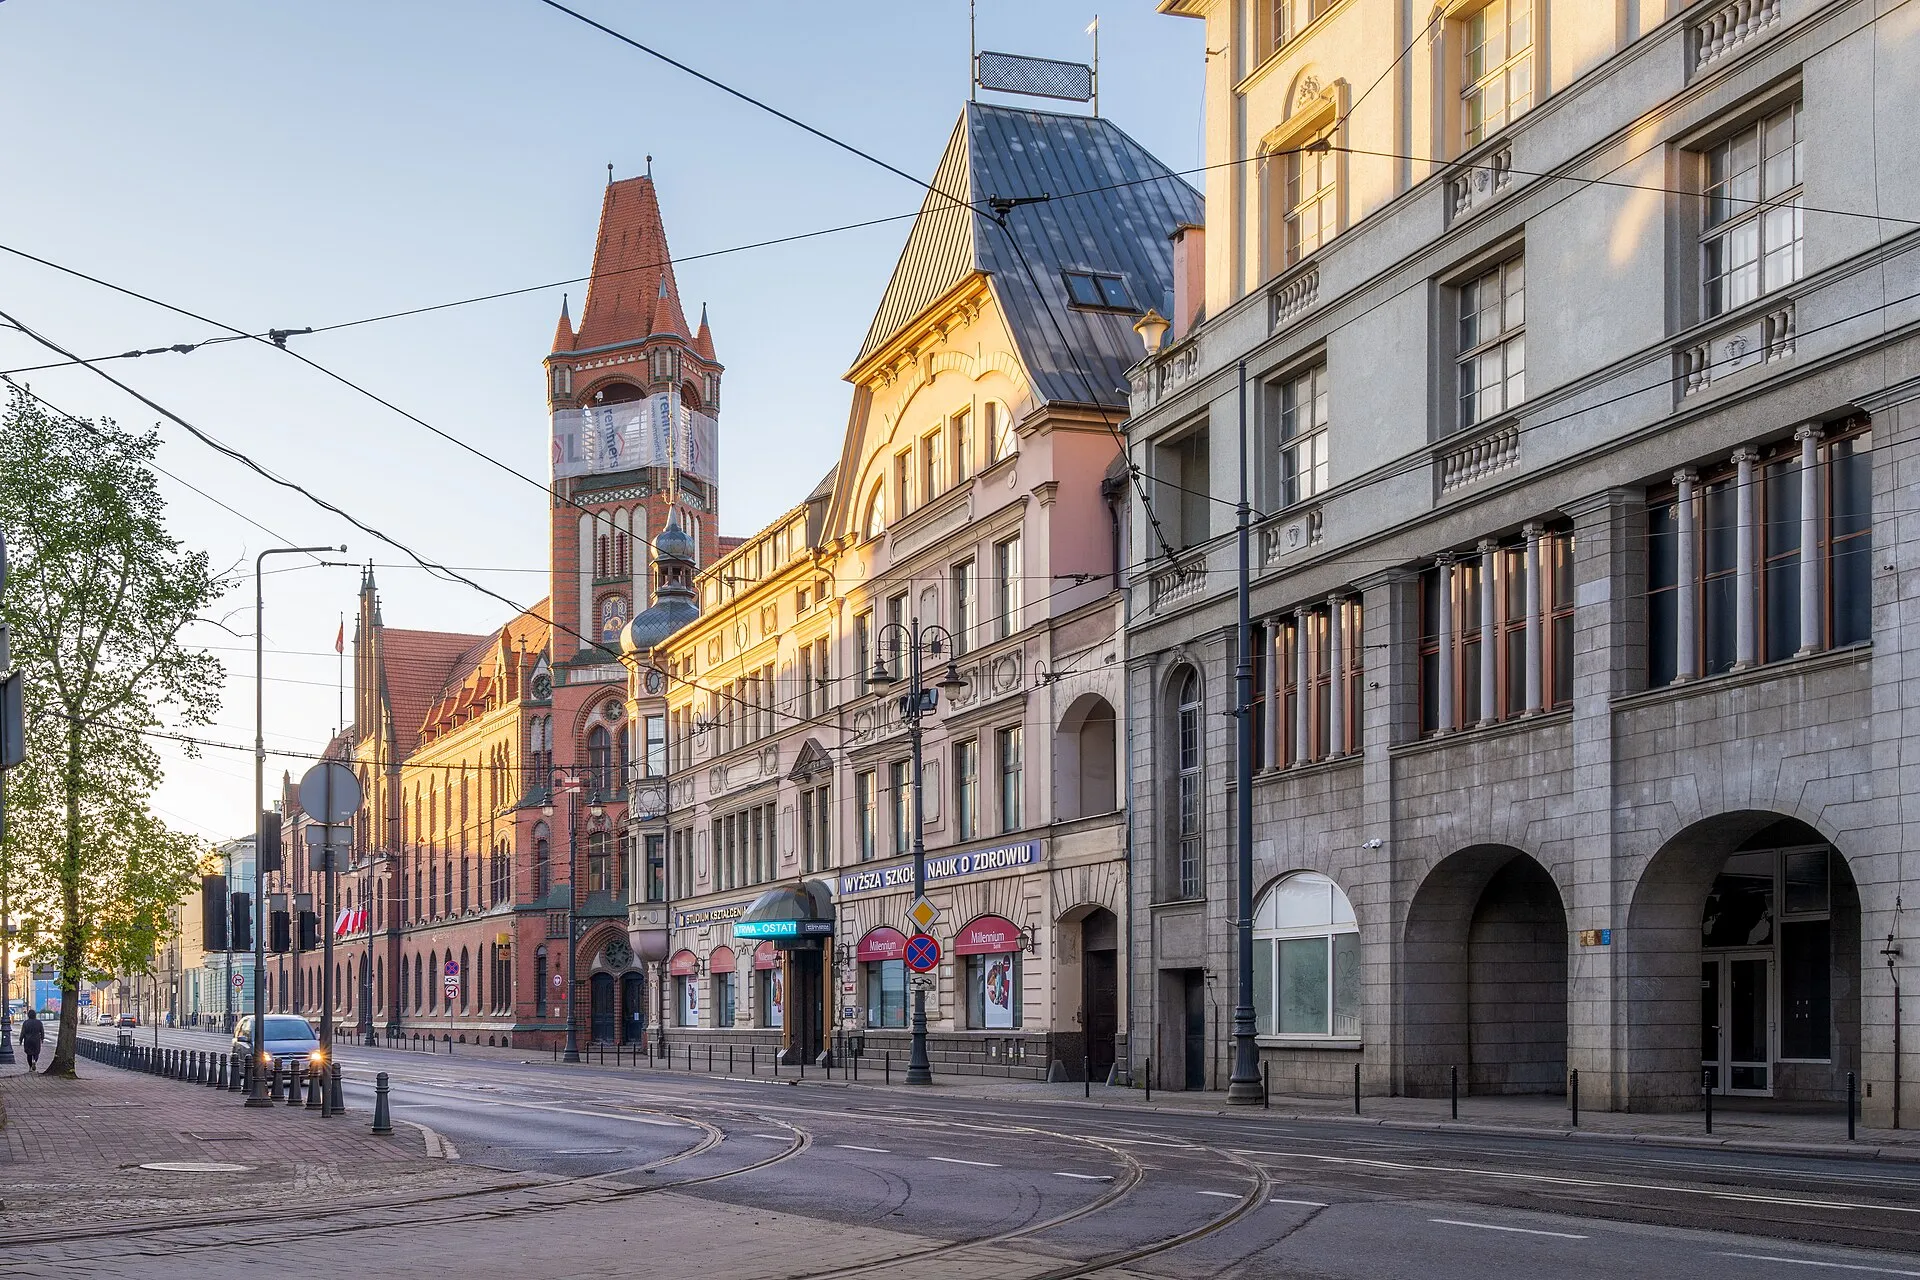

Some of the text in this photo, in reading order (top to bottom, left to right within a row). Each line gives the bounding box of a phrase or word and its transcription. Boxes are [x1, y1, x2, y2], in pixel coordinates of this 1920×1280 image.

[604, 408, 619, 469] remmers
[844, 844, 1031, 892] WYŻSZA SZKOŁ NAUK O ZDROWIU
[686, 911, 710, 924] STUDIUM
[971, 930, 1005, 944] Millennium
[870, 939, 897, 951] Millennium
